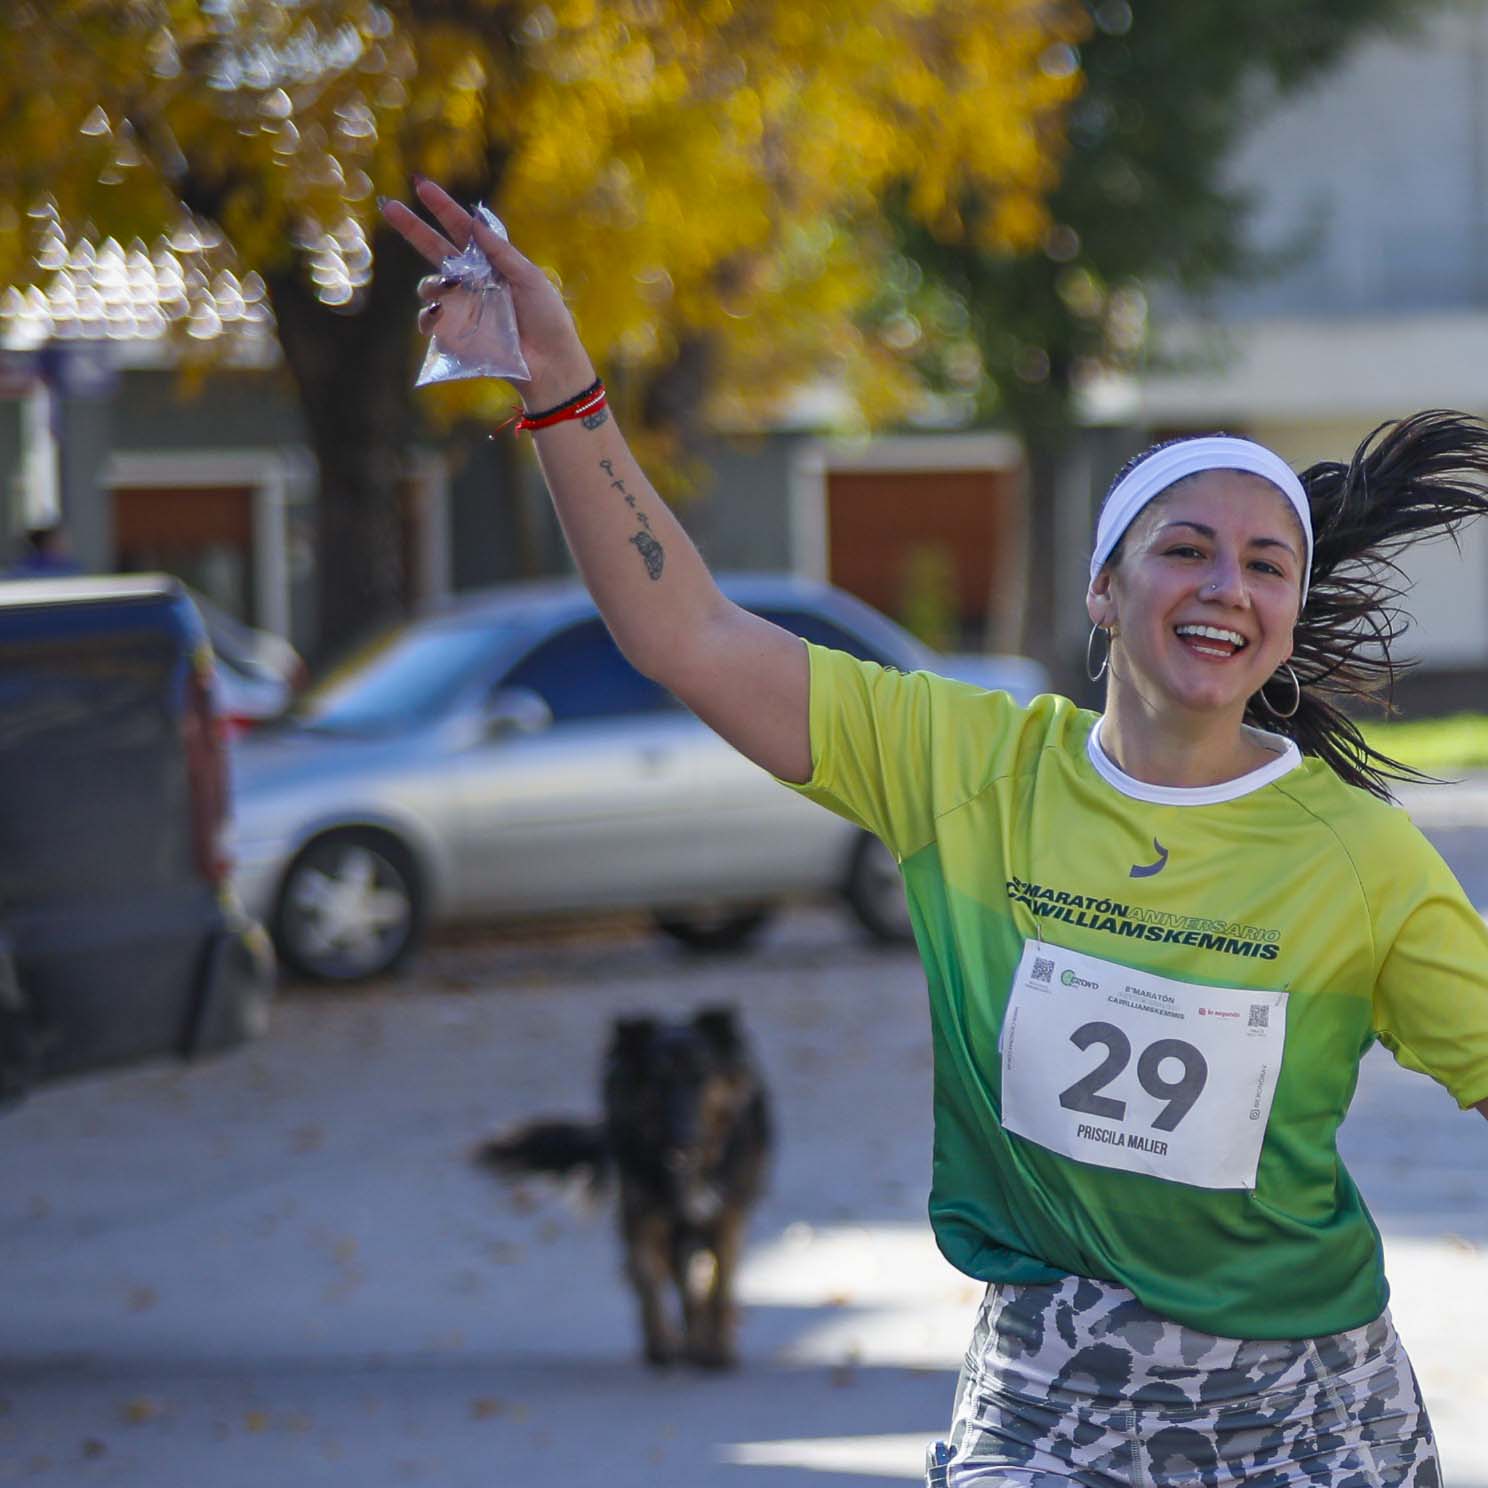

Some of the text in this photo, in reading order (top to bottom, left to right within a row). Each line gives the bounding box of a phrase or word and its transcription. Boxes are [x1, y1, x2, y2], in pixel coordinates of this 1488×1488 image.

[1128, 906, 1282, 943] ANIVERSARIO
[1058, 1020, 1209, 1133] 29
[1076, 1123, 1169, 1156] PRISCILA MALIER
